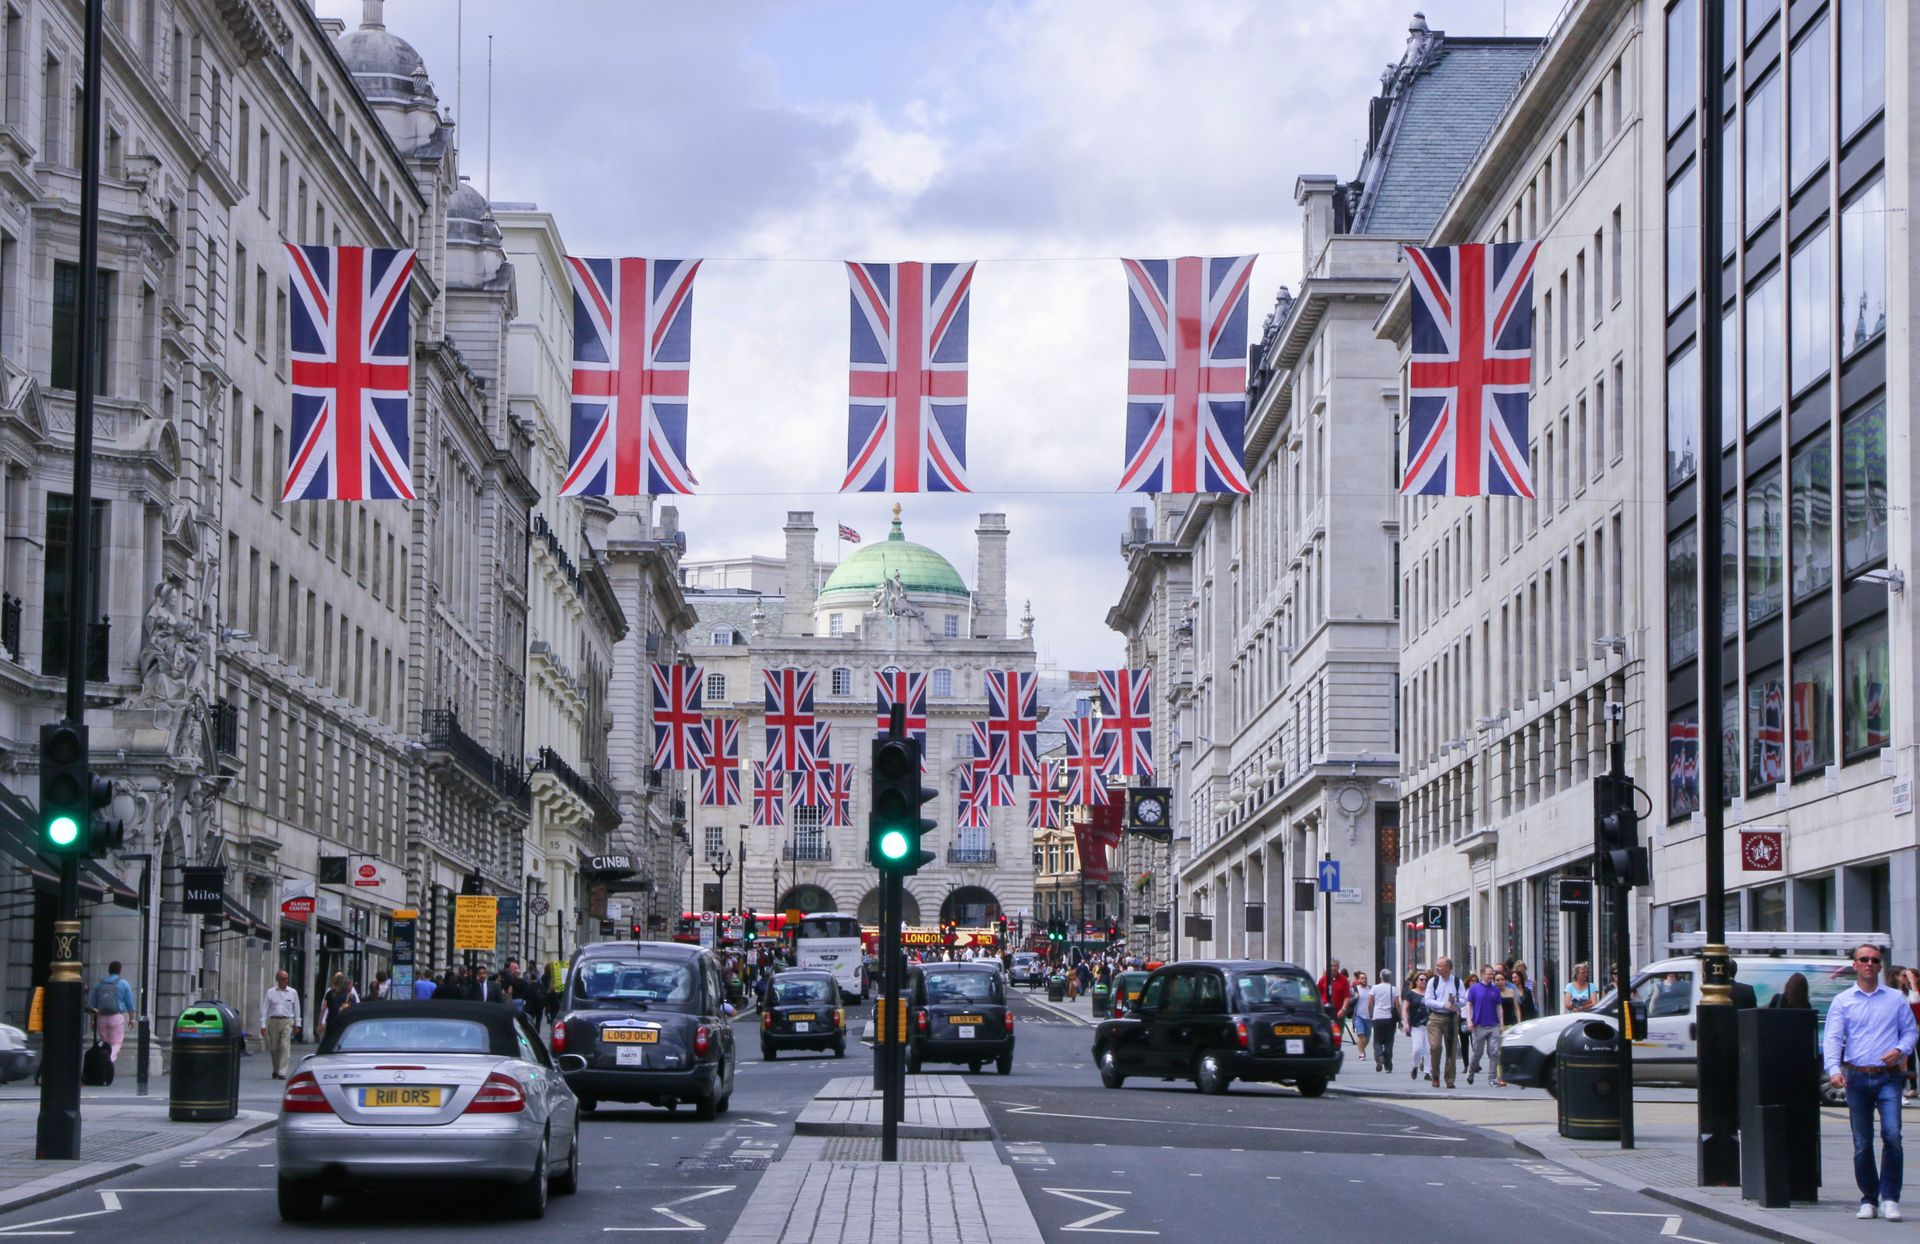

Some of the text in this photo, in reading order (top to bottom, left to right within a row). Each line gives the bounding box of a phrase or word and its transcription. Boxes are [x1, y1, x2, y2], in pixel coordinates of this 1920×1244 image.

[550, 841, 560, 849] 15
[592, 856, 630, 869] CINEMA
[187, 889, 221, 901] Milos
[905, 934, 944, 943] LONDON
[401, 1088, 431, 1105] ORS
